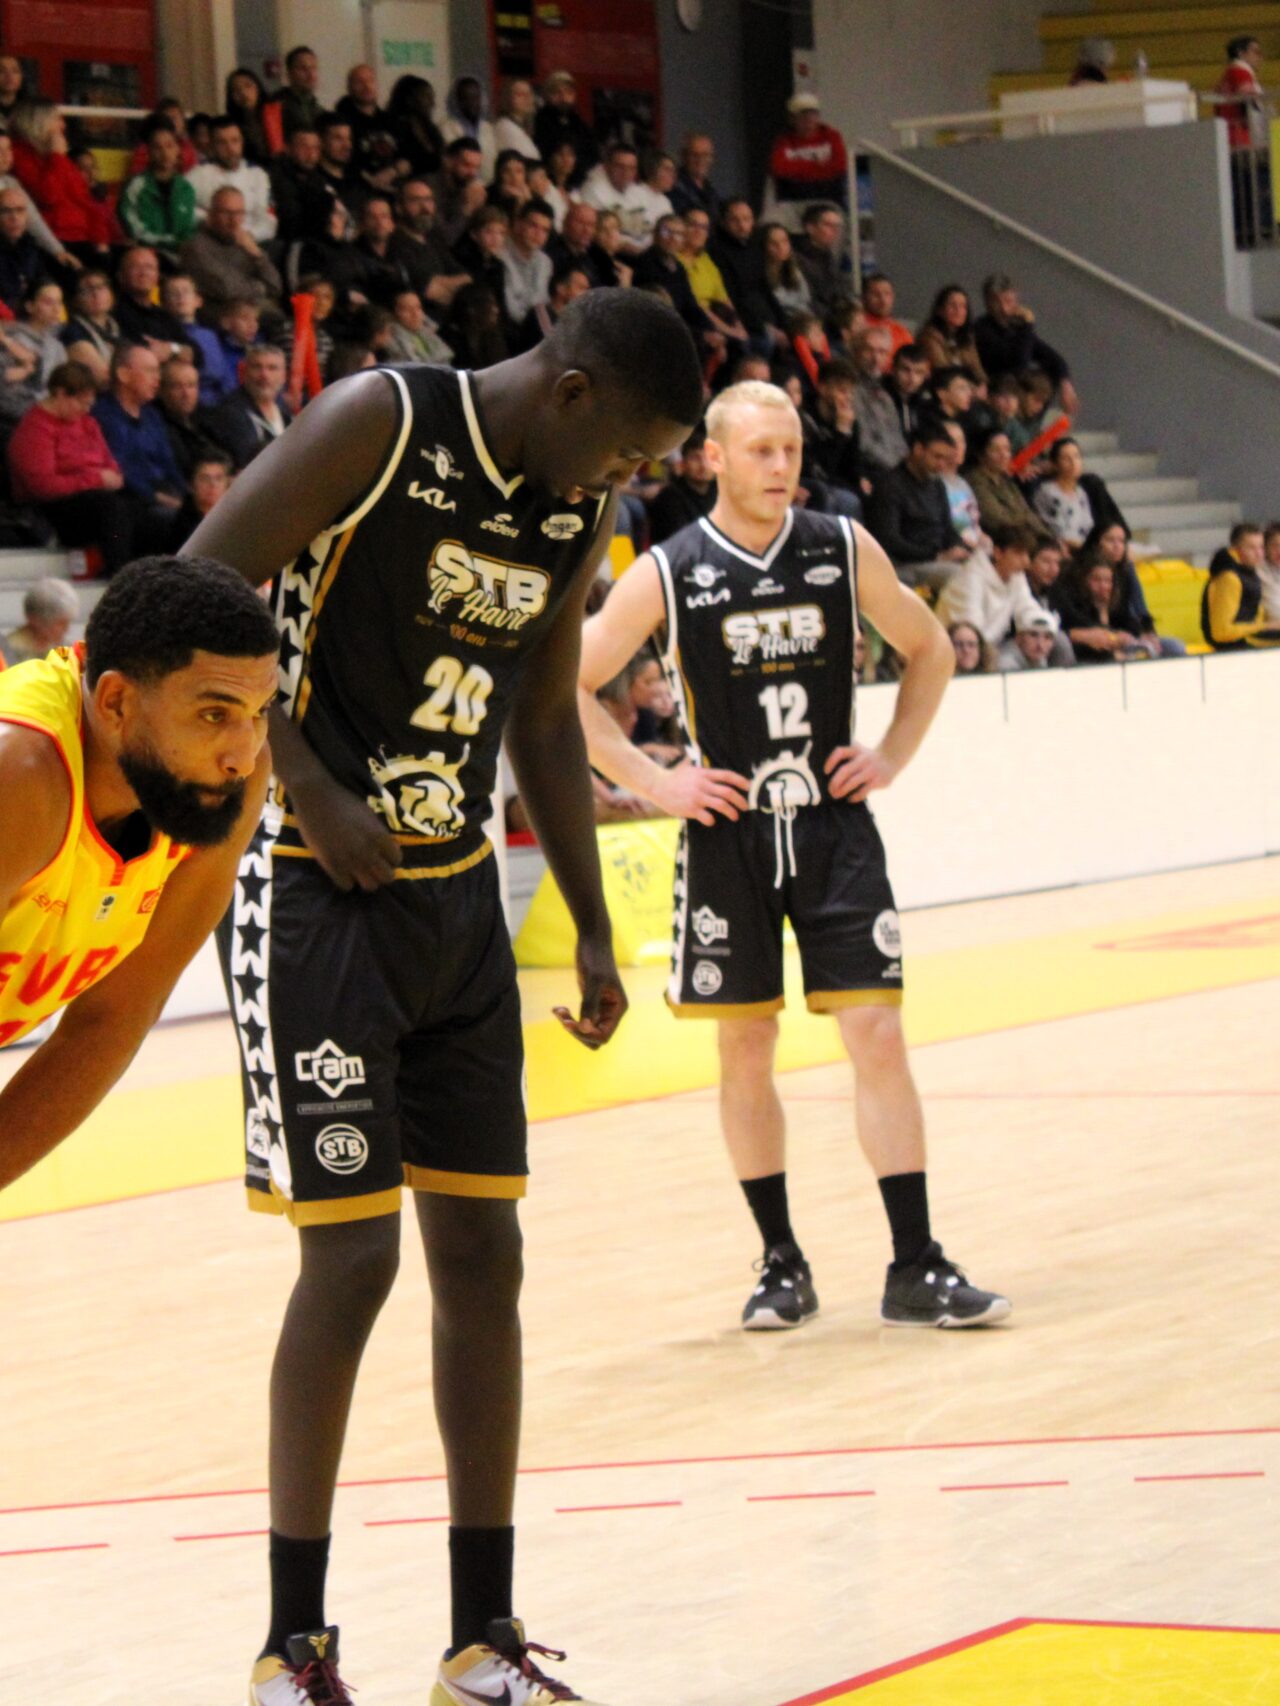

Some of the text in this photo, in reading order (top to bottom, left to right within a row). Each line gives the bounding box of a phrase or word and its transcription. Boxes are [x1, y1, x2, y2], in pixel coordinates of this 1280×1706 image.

[429, 542, 549, 616] STB
[458, 588, 531, 631] Havre
[723, 606, 824, 654] STB
[408, 655, 495, 736] 20
[758, 682, 813, 741] 12
[322, 1136, 363, 1161] STB
